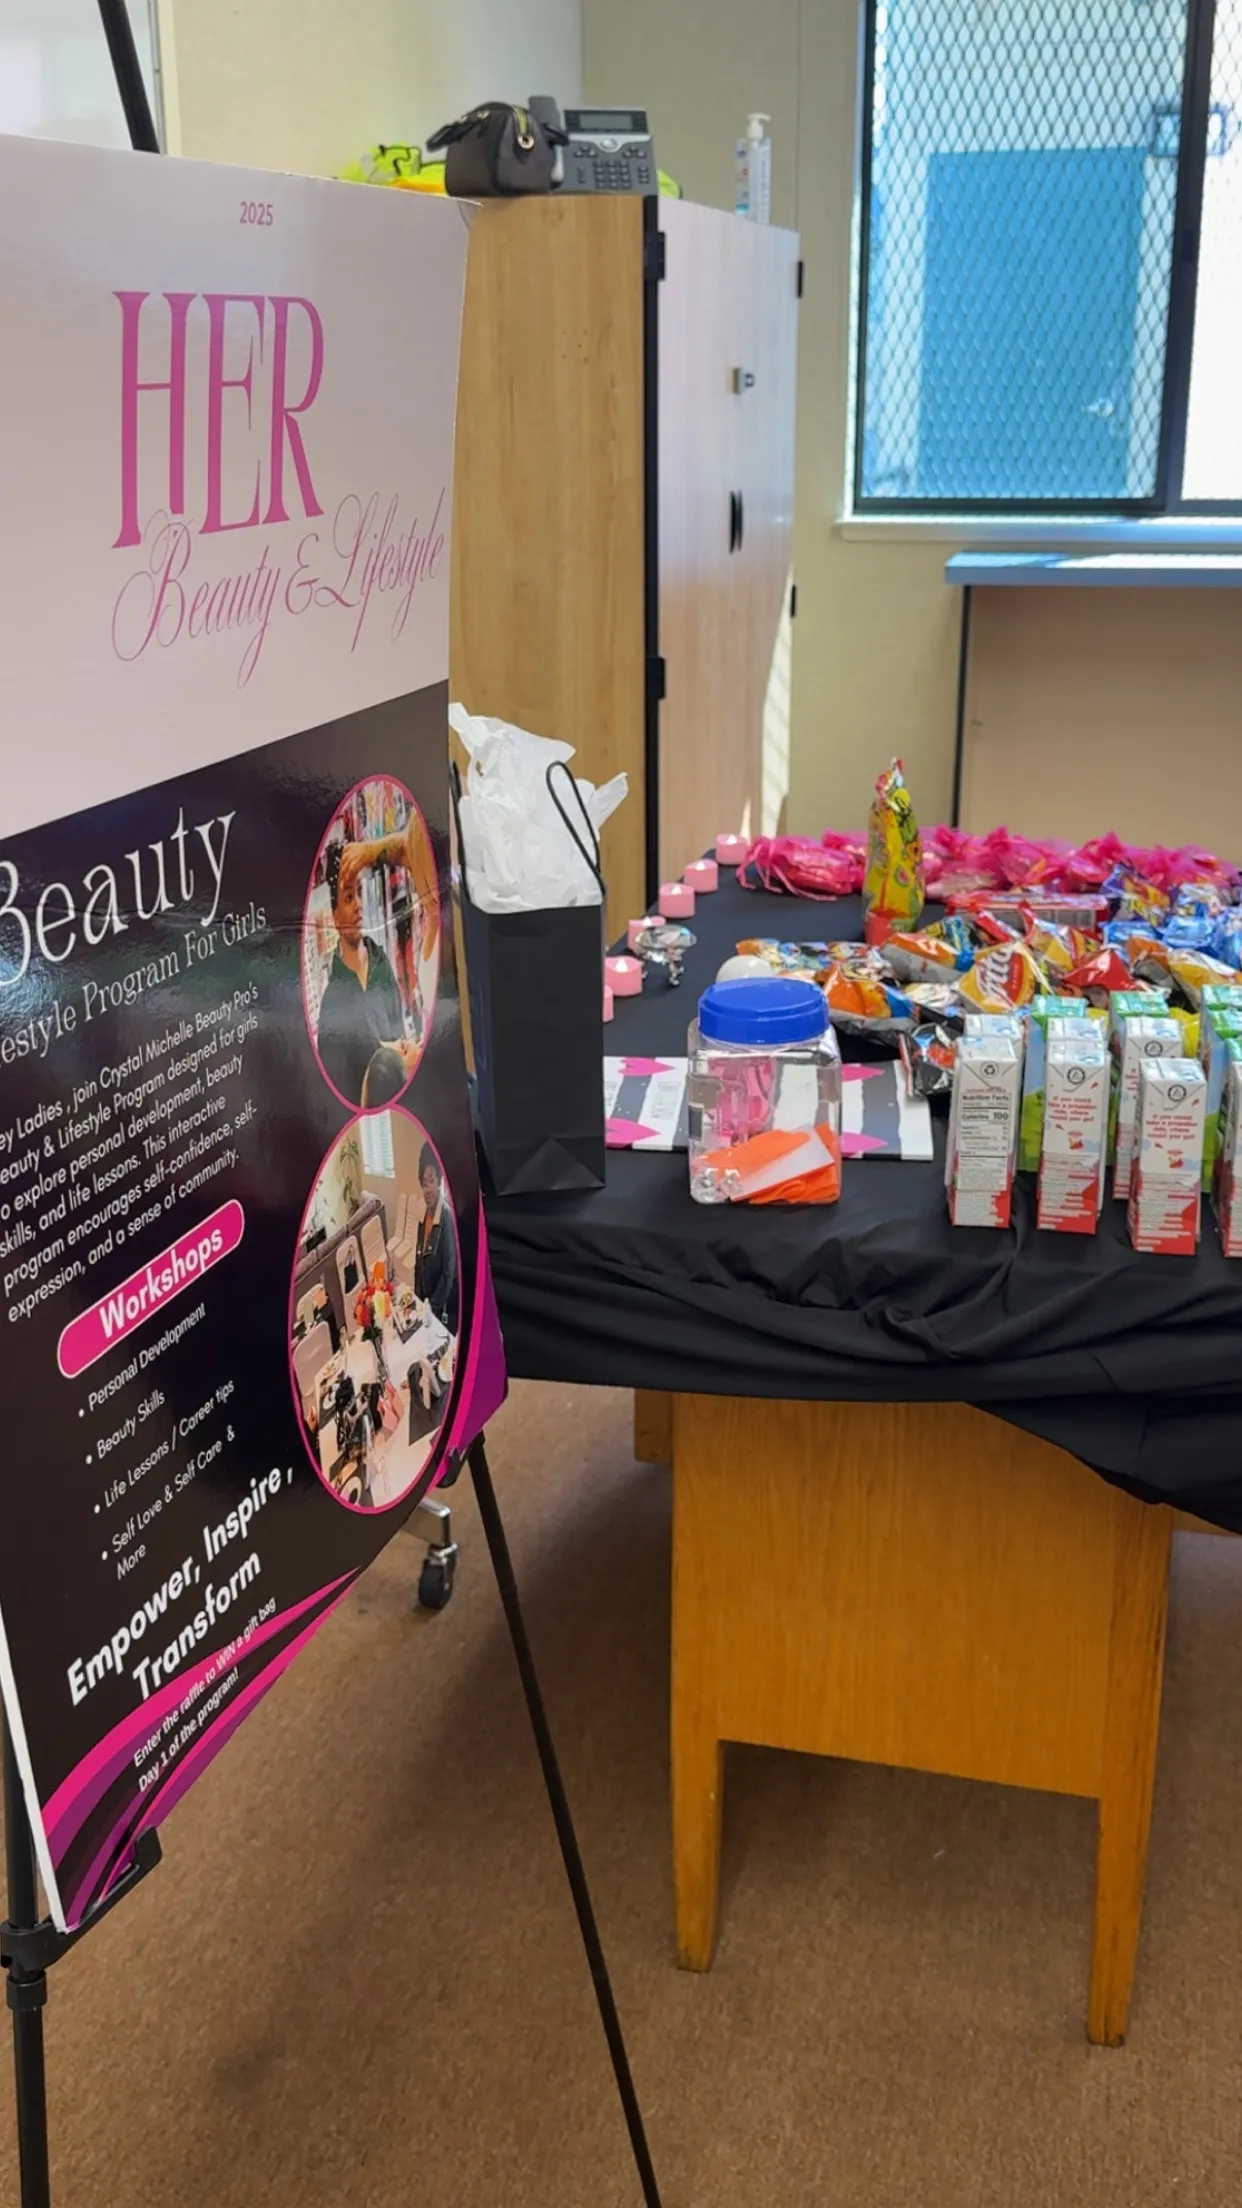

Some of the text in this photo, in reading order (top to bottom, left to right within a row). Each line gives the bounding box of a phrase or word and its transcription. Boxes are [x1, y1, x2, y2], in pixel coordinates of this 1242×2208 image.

[239, 201, 274, 226] 2025
[111, 291, 325, 549] HER
[111, 486, 445, 689] Beauty & Lifestyle
[0, 806, 236, 986] Beauty
[0, 902, 267, 1065] estyle Program For Girls
[0, 1127, 14, 1154] ey
[16, 1101, 63, 1140] Ladies
[73, 1081, 98, 1114] join
[100, 1045, 143, 1089] Crystal
[146, 1020, 194, 1063] Michelle
[195, 1001, 232, 1033] Beauty
[233, 981, 259, 1011] Pro's
[0, 1012, 259, 1185] eauty & Lifestyle Program designed for girls
[14, 1168, 67, 1211] explore
[70, 1121, 126, 1183] personal
[128, 1077, 206, 1138] development,
[205, 1054, 243, 1087] beauty
[993, 1111, 1009, 1120] 100
[0, 1096, 226, 1258] skills, and life lessons. This interactive
[4, 1099, 258, 1298] program encourages self-confidence, self-
[8, 1148, 240, 1322] expression, and a sense of community.
[88, 1302, 206, 1412] Personal Development
[99, 1228, 224, 1339] Workshops
[96, 1389, 166, 1460] Beauty Skills
[104, 1480, 127, 1508] Life
[128, 1441, 170, 1486] Lessons
[179, 1398, 214, 1436] Career
[215, 1380, 235, 1404] tips
[112, 1424, 236, 1553] Self Love & Self Care &
[66, 1557, 202, 1707] Empower,
[202, 1468, 282, 1563] Inspire
[116, 1544, 147, 1581] More
[132, 1552, 261, 1701] Transform
[133, 1597, 276, 1768] Enter the raffle to WIN a gift bag
[138, 1667, 239, 1793] Day 1 of the program!
